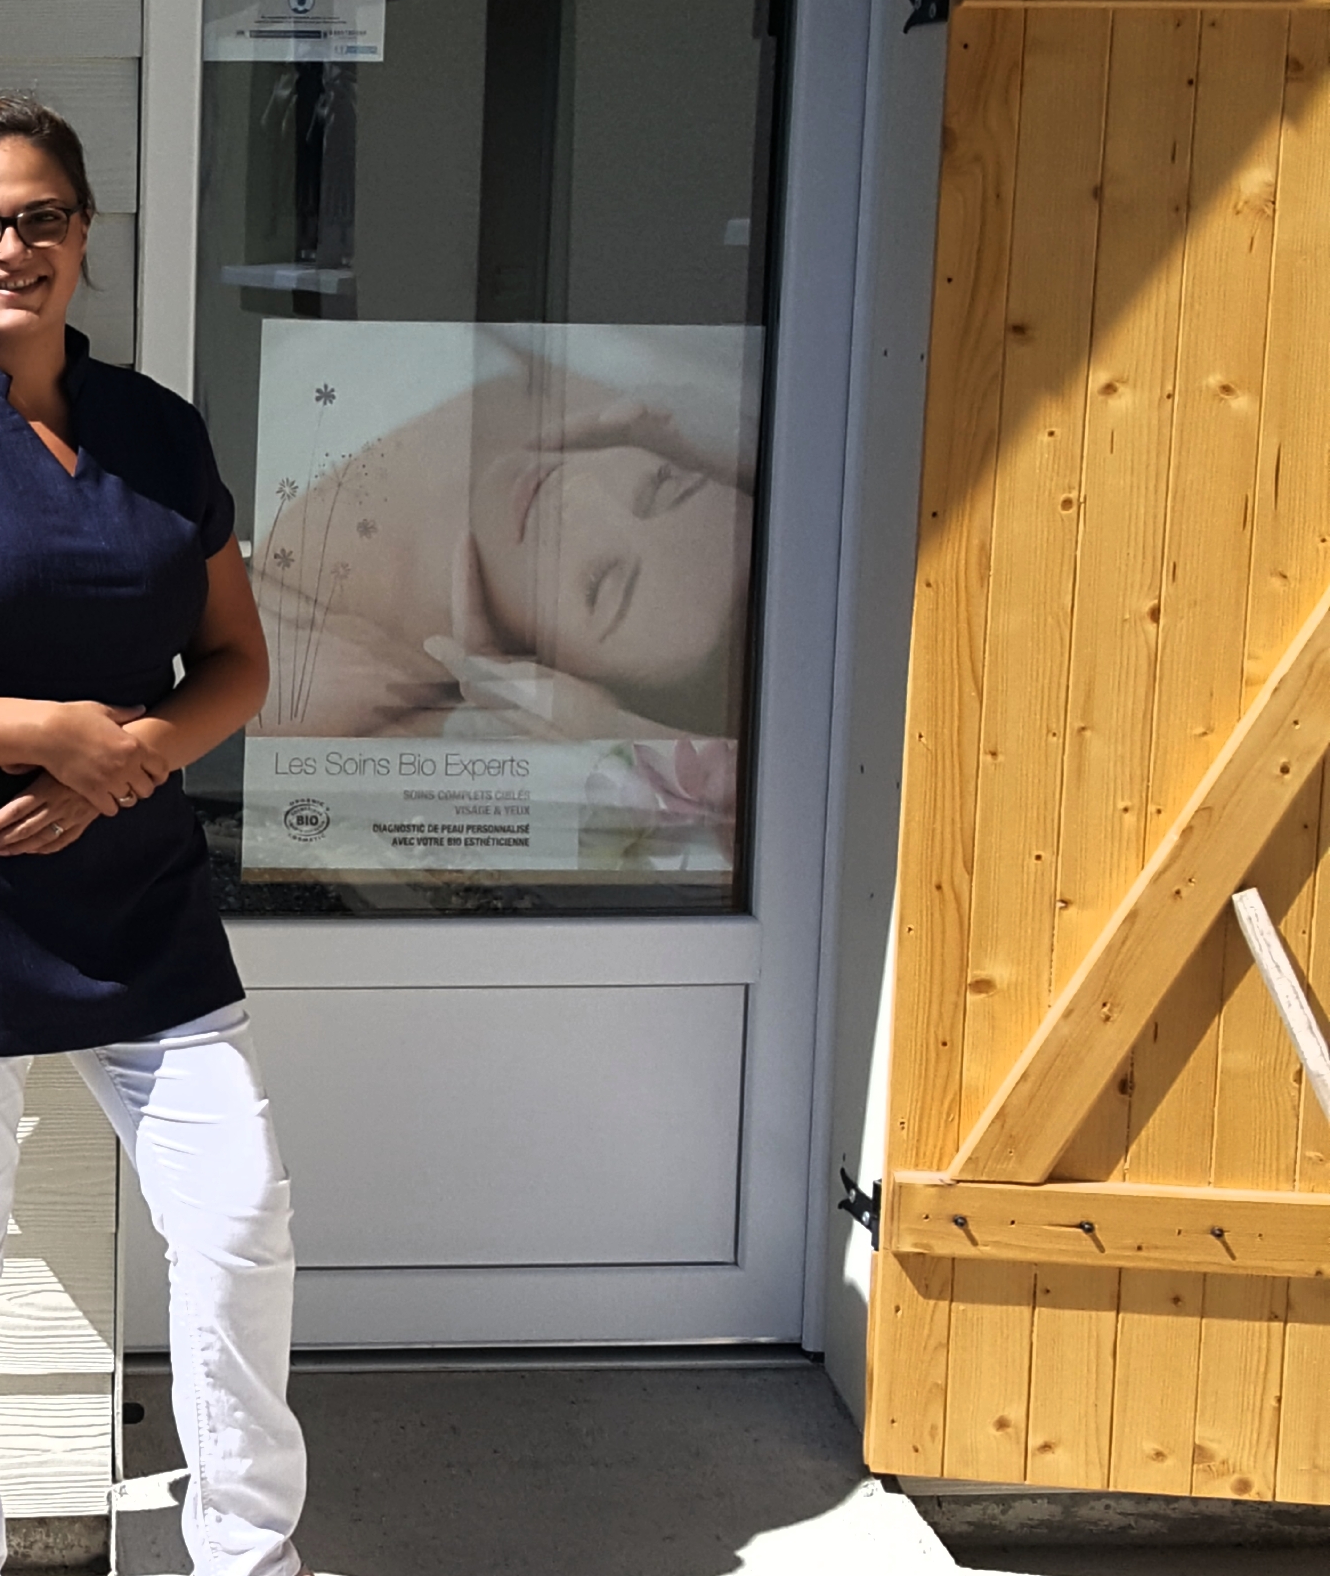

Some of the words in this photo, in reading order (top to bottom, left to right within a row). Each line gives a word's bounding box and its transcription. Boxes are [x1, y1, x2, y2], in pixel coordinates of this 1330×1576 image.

[274, 752, 317, 775] Les
[325, 752, 390, 776] Soins
[398, 753, 436, 776] Bio
[445, 753, 530, 780] Experts
[403, 789, 435, 800] SOINS
[437, 790, 492, 800] COMPLETS
[455, 805, 491, 815] VISAGE
[503, 805, 530, 815] YEUX
[296, 815, 319, 826] BIO
[372, 823, 425, 834] DIAGNOSTIC
[427, 824, 439, 834] DE
[441, 824, 464, 834] PEAU
[466, 822, 530, 834] PERSONNALISÉ
[391, 837, 415, 847] AVEC
[416, 837, 445, 847] VOTRE
[447, 837, 462, 847] BIO
[464, 835, 530, 847] ESTHÉTICIENNE
